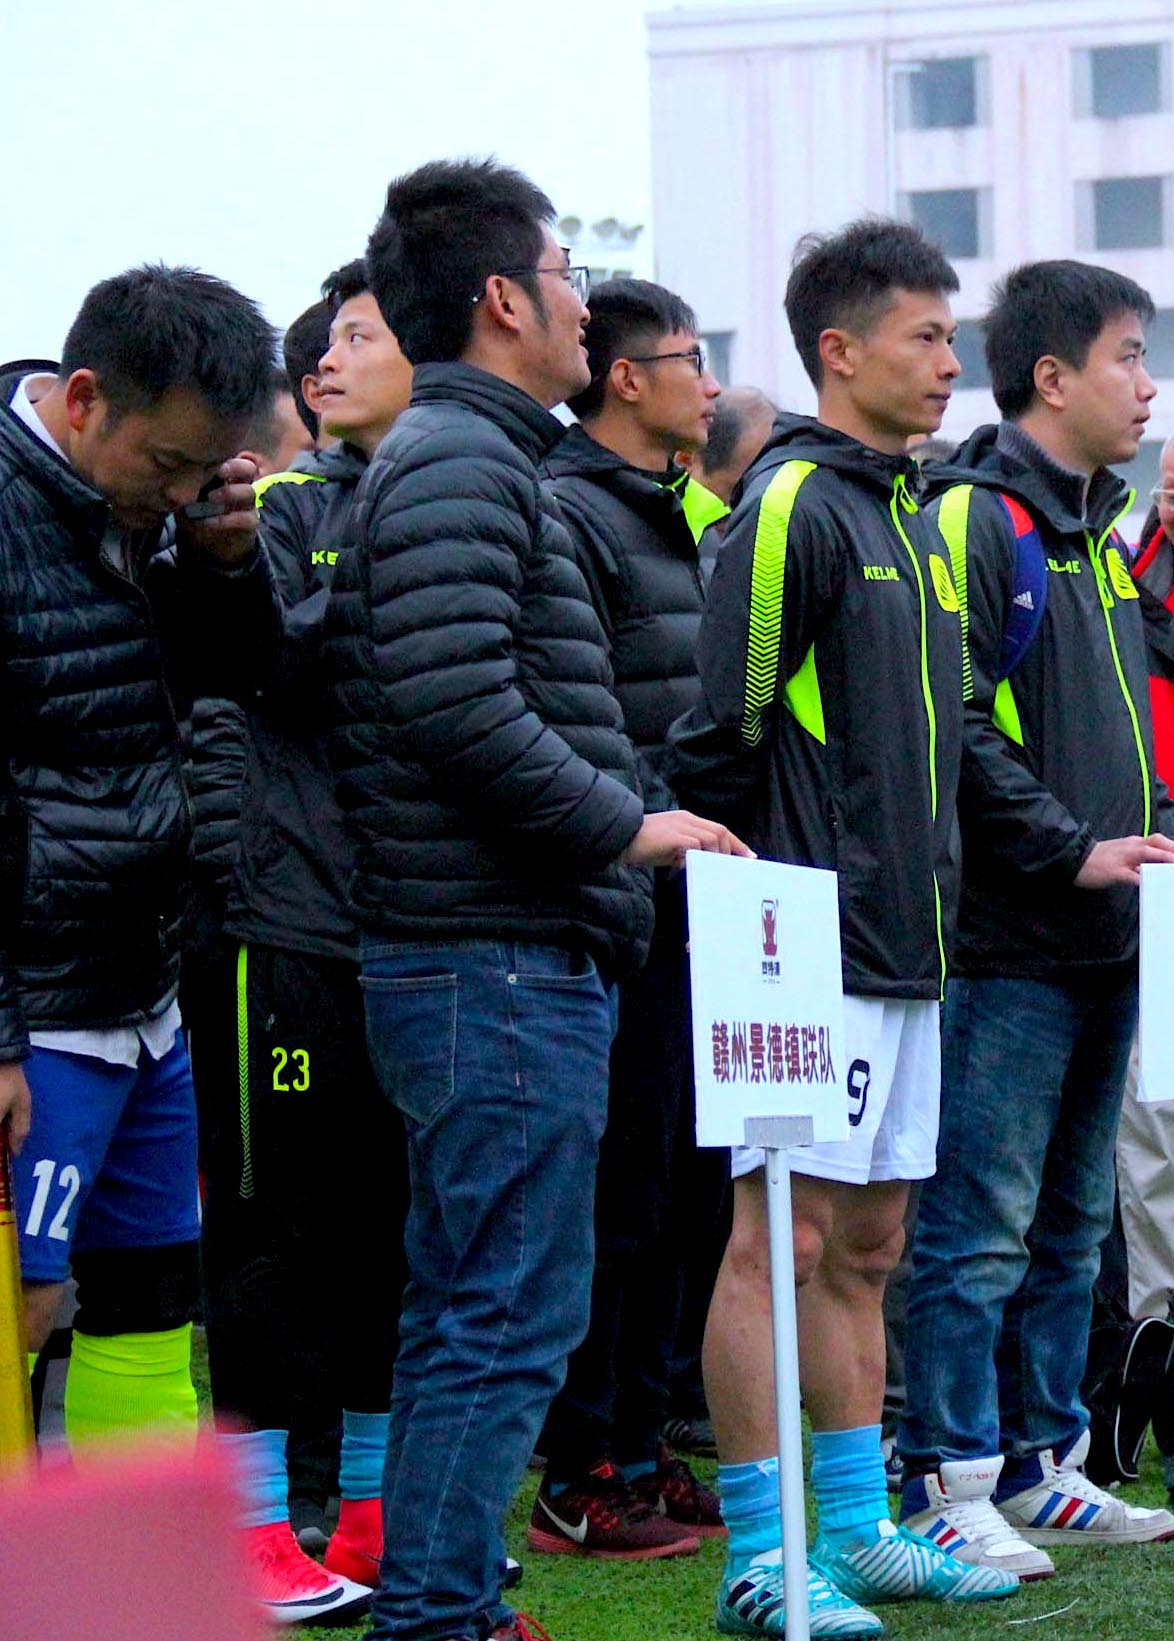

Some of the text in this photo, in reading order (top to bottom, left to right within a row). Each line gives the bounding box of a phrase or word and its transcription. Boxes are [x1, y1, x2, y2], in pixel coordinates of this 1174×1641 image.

[271, 1047, 310, 1091] 23
[711, 1018, 837, 1085] 赣州景德镇联队
[847, 1058, 871, 1127] 9
[24, 1158, 81, 1242] 12
